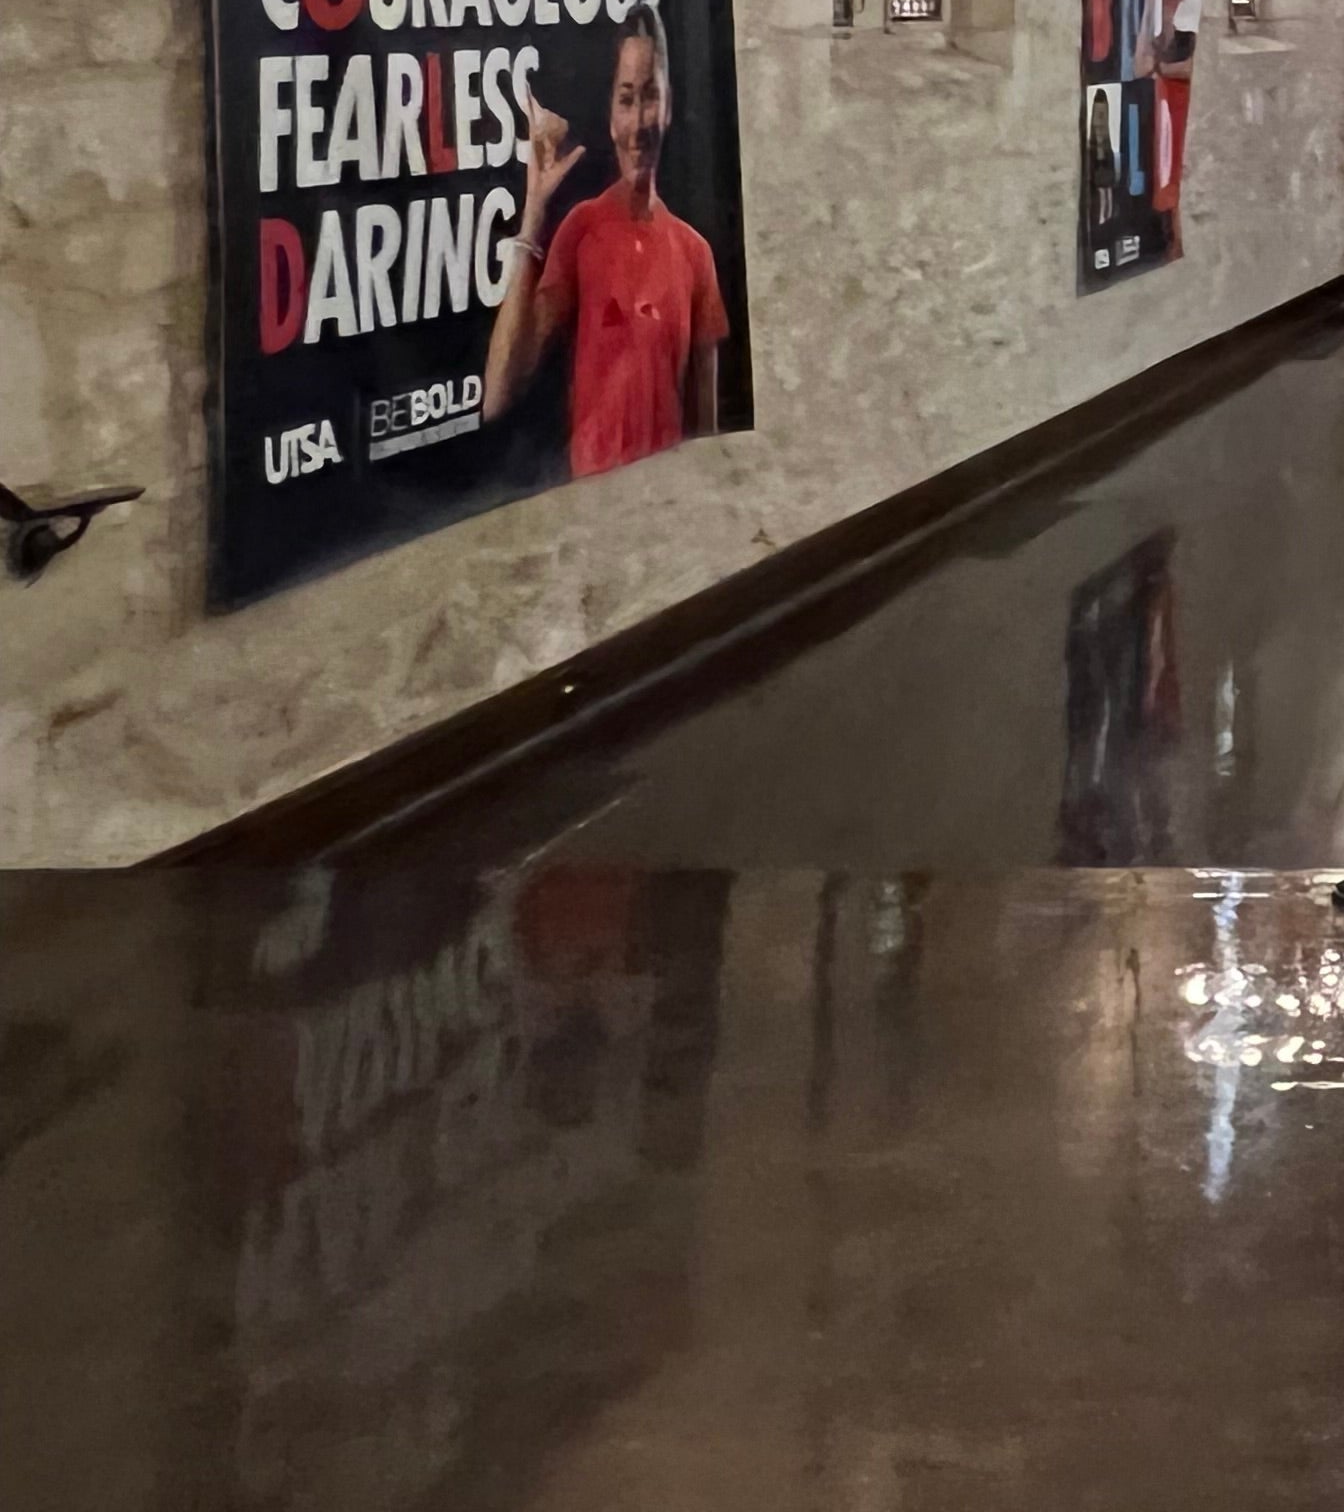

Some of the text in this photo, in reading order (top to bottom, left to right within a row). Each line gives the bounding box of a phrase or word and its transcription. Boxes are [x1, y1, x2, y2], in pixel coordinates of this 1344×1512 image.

[259, 45, 540, 192] FEARLESS
[260, 187, 516, 355] DARING
[264, 419, 342, 484] UTSA
[371, 393, 409, 437] BE
[410, 375, 482, 426] BOLD
